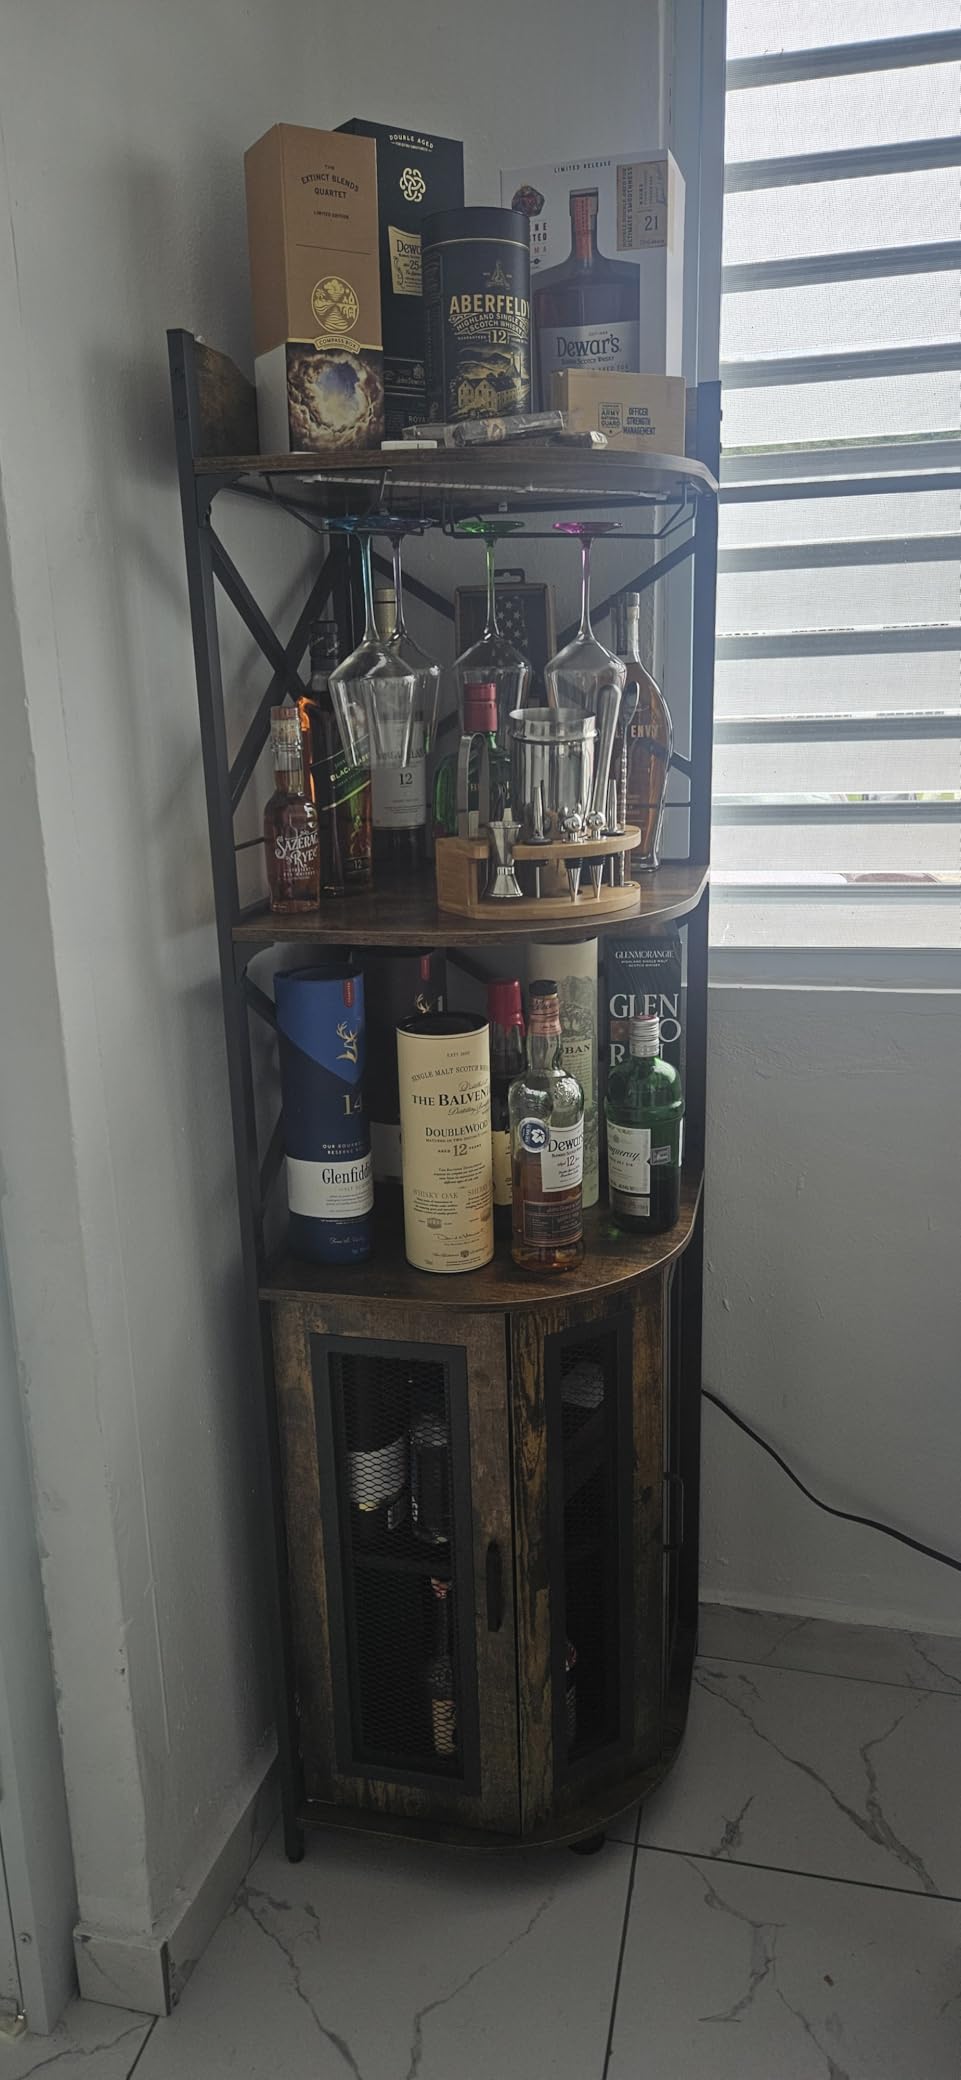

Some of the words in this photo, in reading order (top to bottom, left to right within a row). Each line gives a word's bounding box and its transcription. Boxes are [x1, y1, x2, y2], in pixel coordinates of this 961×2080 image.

[390, 134, 414, 142] DOUBLE
[417, 138, 434, 149] AGED
[554, 163, 580, 174] LIMITED
[583, 160, 611, 170] RELEASE
[301, 173, 330, 184] EXTINCT
[332, 173, 359, 192] BLENDS
[314, 187, 347, 199] QUARTET
[644, 215, 659, 232] 21
[456, 313, 494, 331] HIGHLAND
[496, 313, 520, 326] SINGLE
[469, 320, 499, 332] SCOTCH
[491, 329, 507, 344] 12
[556, 333, 620, 357] Dewar's
[628, 407, 649, 416] OFFICER
[626, 417, 651, 426] STRENGTH
[623, 427, 656, 436] MANAGEMENT
[631, 725, 659, 737] ENVY
[329, 761, 351, 778] BLAC
[400, 772, 413, 786] 12
[275, 832, 319, 859] SAZERAC
[615, 950, 674, 959] GLENMORANGIE
[609, 993, 679, 1018] GLEN
[562, 1044, 590, 1055] BAN
[411, 1071, 433, 1081] SINGLE
[435, 1067, 454, 1076] MALT
[341, 1091, 363, 1115] 14
[411, 1094, 435, 1106] THE
[453, 1143, 468, 1157] 12
[567, 1155, 575, 1167] 12
[441, 1192, 459, 1200] OAK
